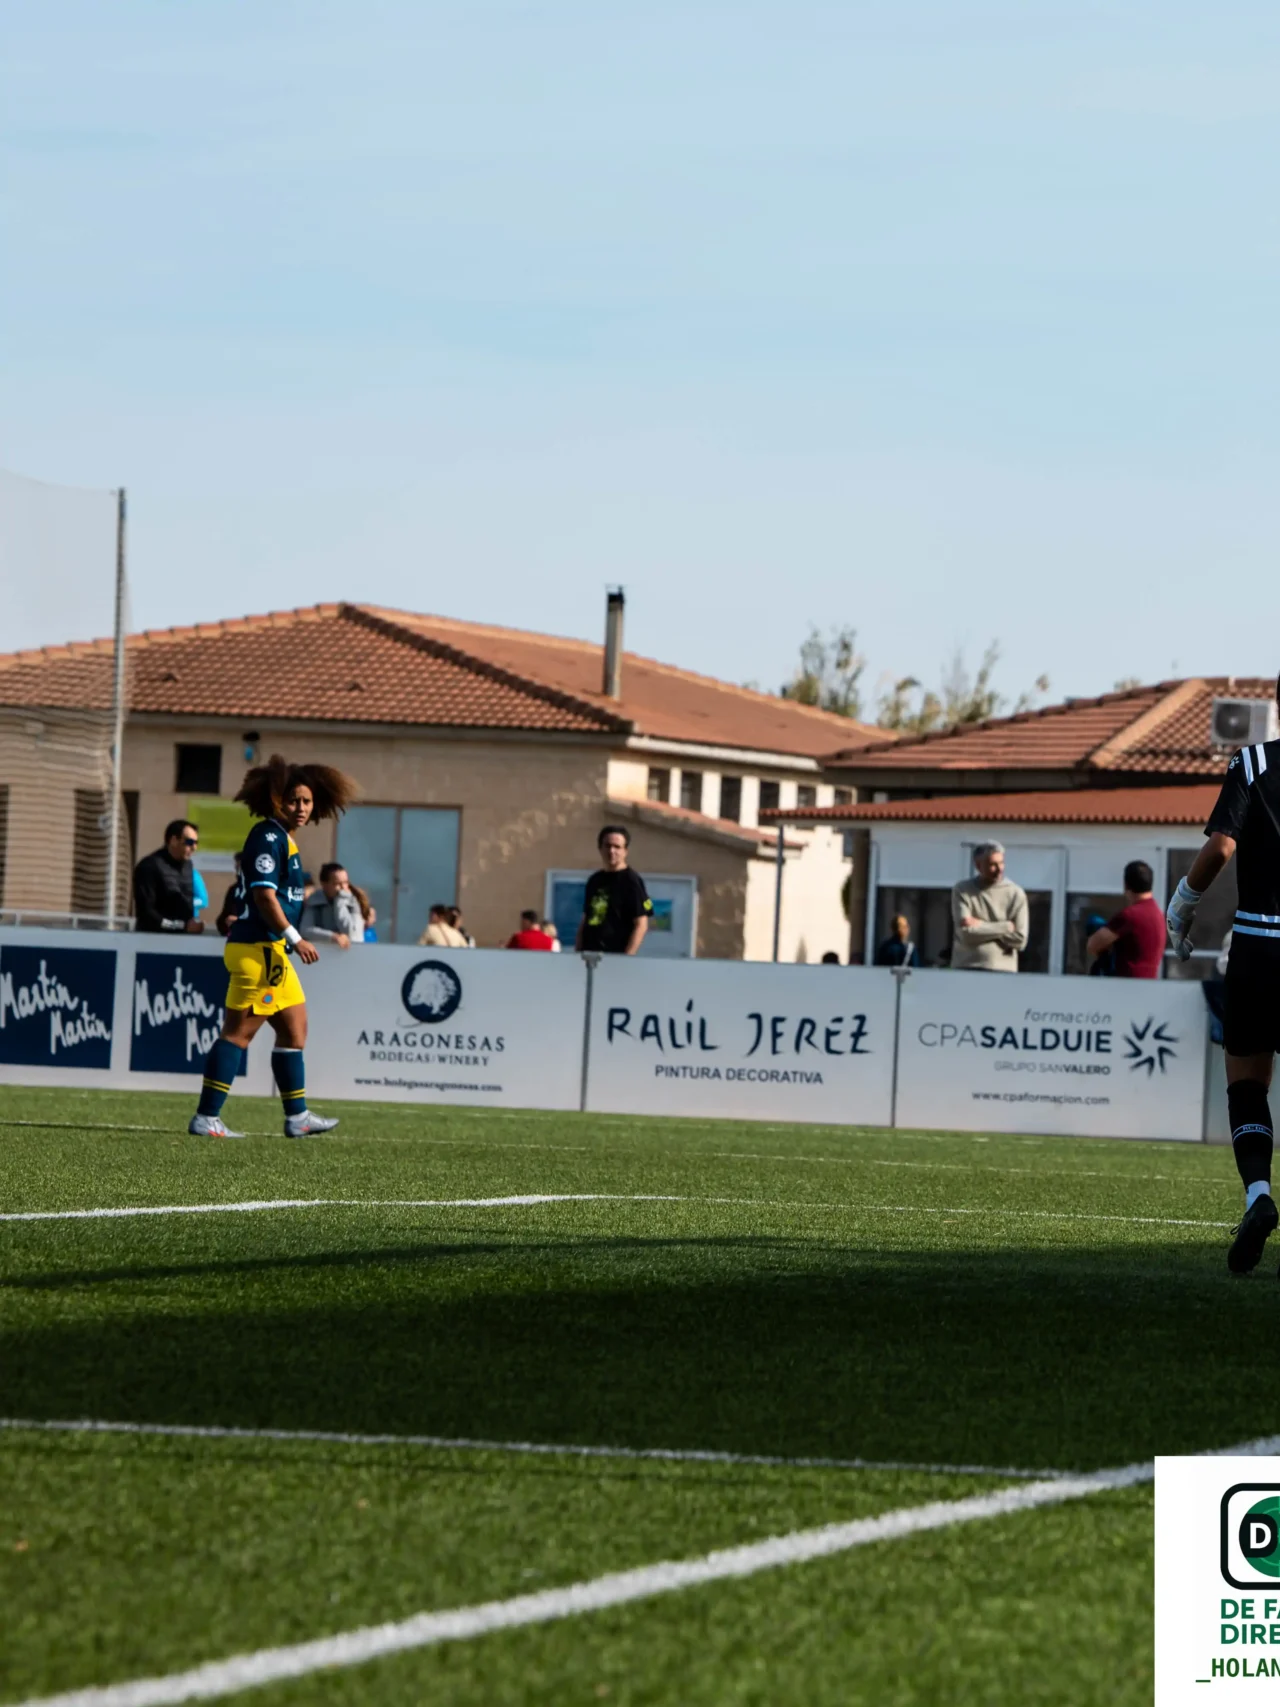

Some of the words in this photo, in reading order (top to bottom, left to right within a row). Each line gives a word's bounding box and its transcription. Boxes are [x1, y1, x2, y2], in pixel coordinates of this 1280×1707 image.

[269, 964, 287, 987] 2
[1023, 1008, 1112, 1025] formación
[185, 1008, 225, 1062] Mart
[357, 1029, 505, 1053] ARAGONESAS
[917, 1021, 1114, 1054] CPASALDUIE
[654, 1064, 722, 1080] PINTURA
[725, 1067, 825, 1085] DECORATIVA
[993, 1060, 1037, 1074] GRUPO
[1038, 1062, 1112, 1077] SANVALERO
[971, 1091, 1111, 1107] www.cpaformacion.com
